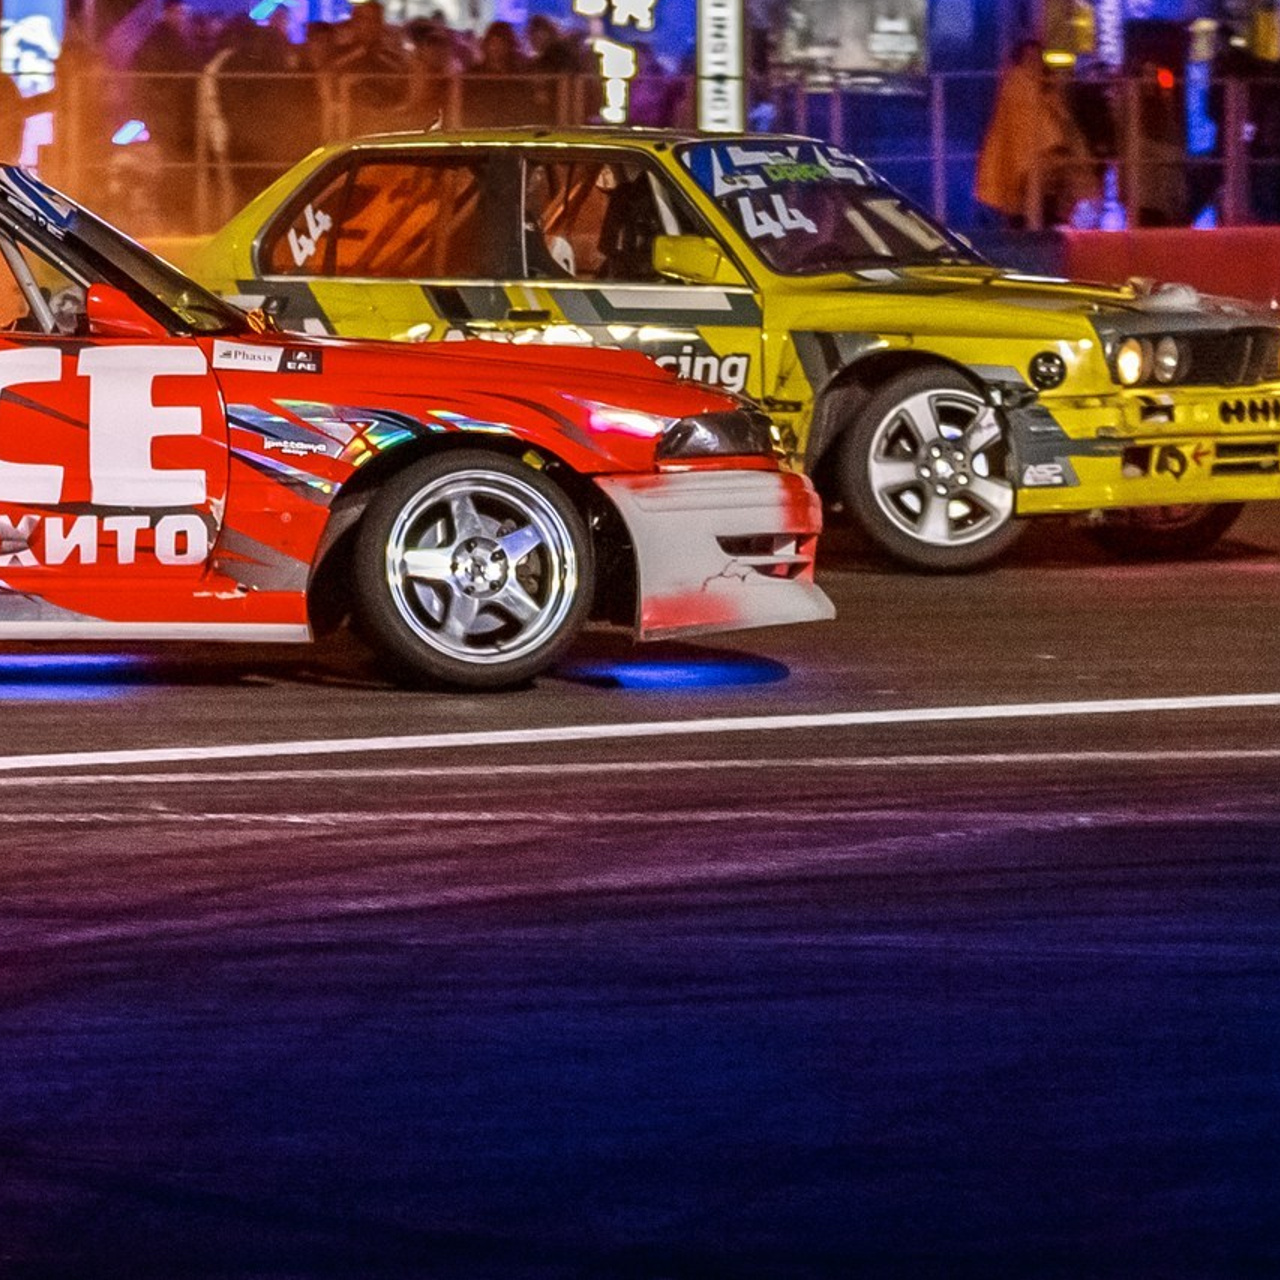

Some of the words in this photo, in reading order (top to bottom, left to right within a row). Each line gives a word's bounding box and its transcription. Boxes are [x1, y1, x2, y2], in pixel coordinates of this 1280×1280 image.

[708, 16, 729, 124] INSTNCT
[287, 203, 333, 267] 44
[737, 194, 818, 239] 44
[233, 350, 273, 362] Phasis
